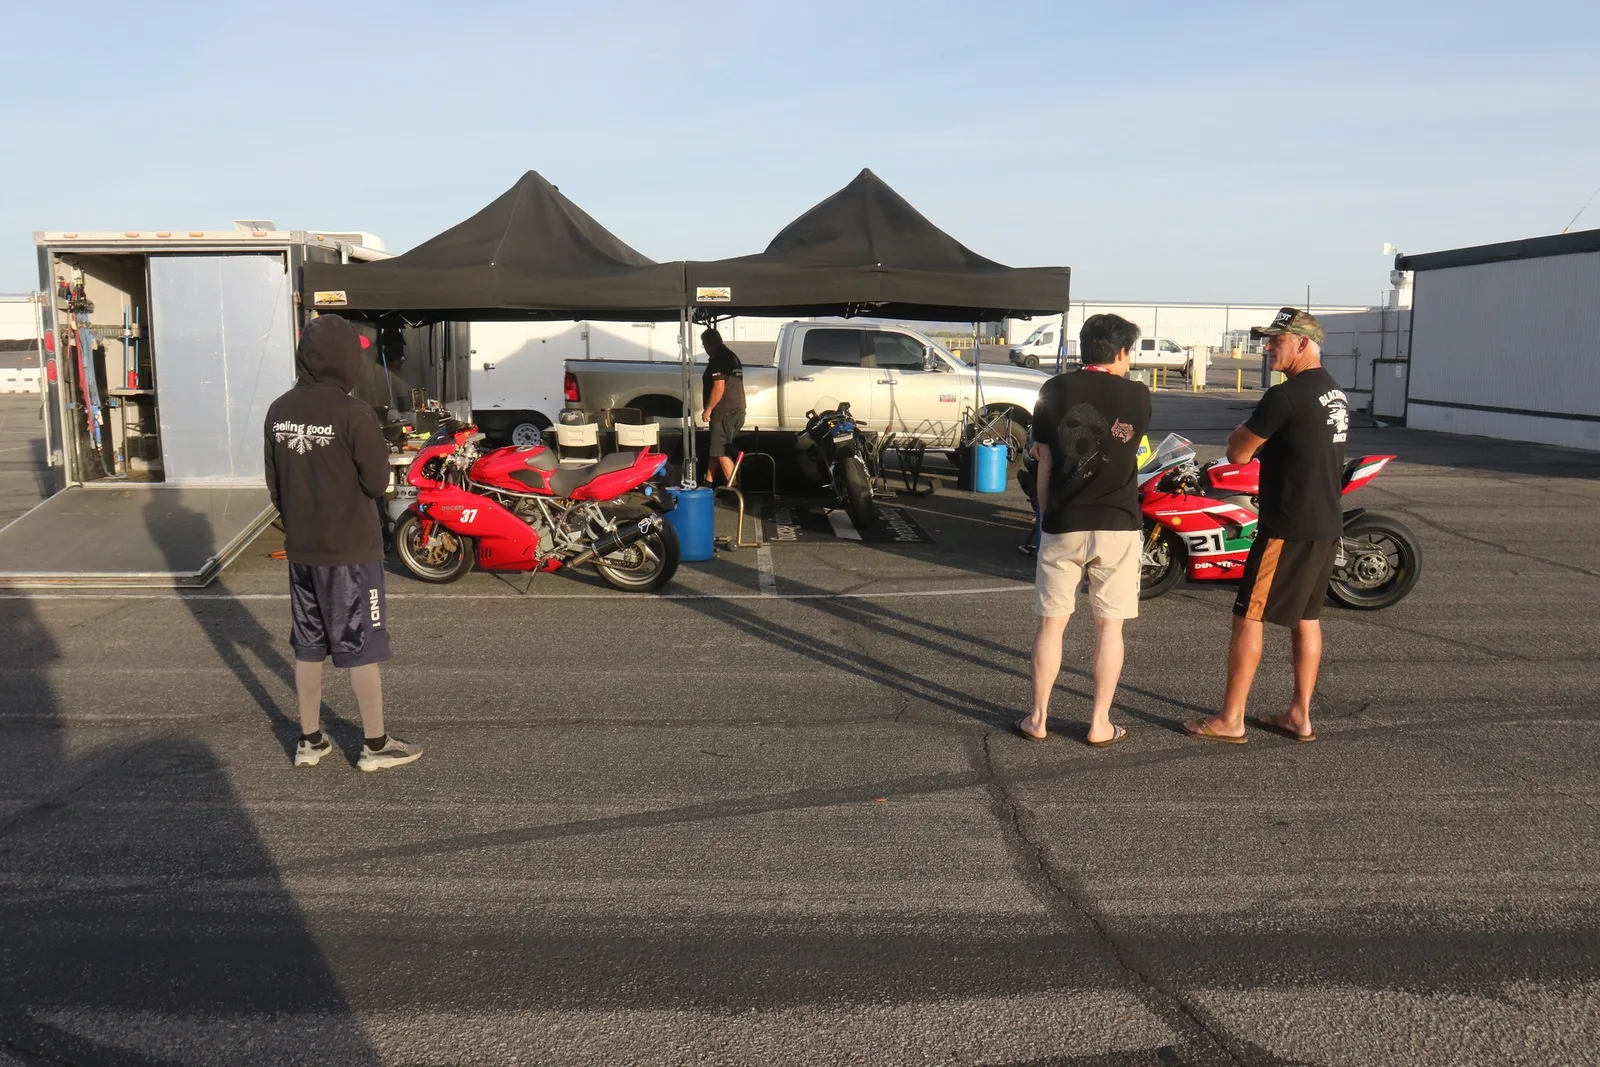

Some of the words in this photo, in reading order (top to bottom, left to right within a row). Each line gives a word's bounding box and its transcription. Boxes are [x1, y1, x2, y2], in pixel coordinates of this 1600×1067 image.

[306, 424, 335, 436] good.
[460, 508, 478, 523] 37
[1188, 533, 1222, 553] 21
